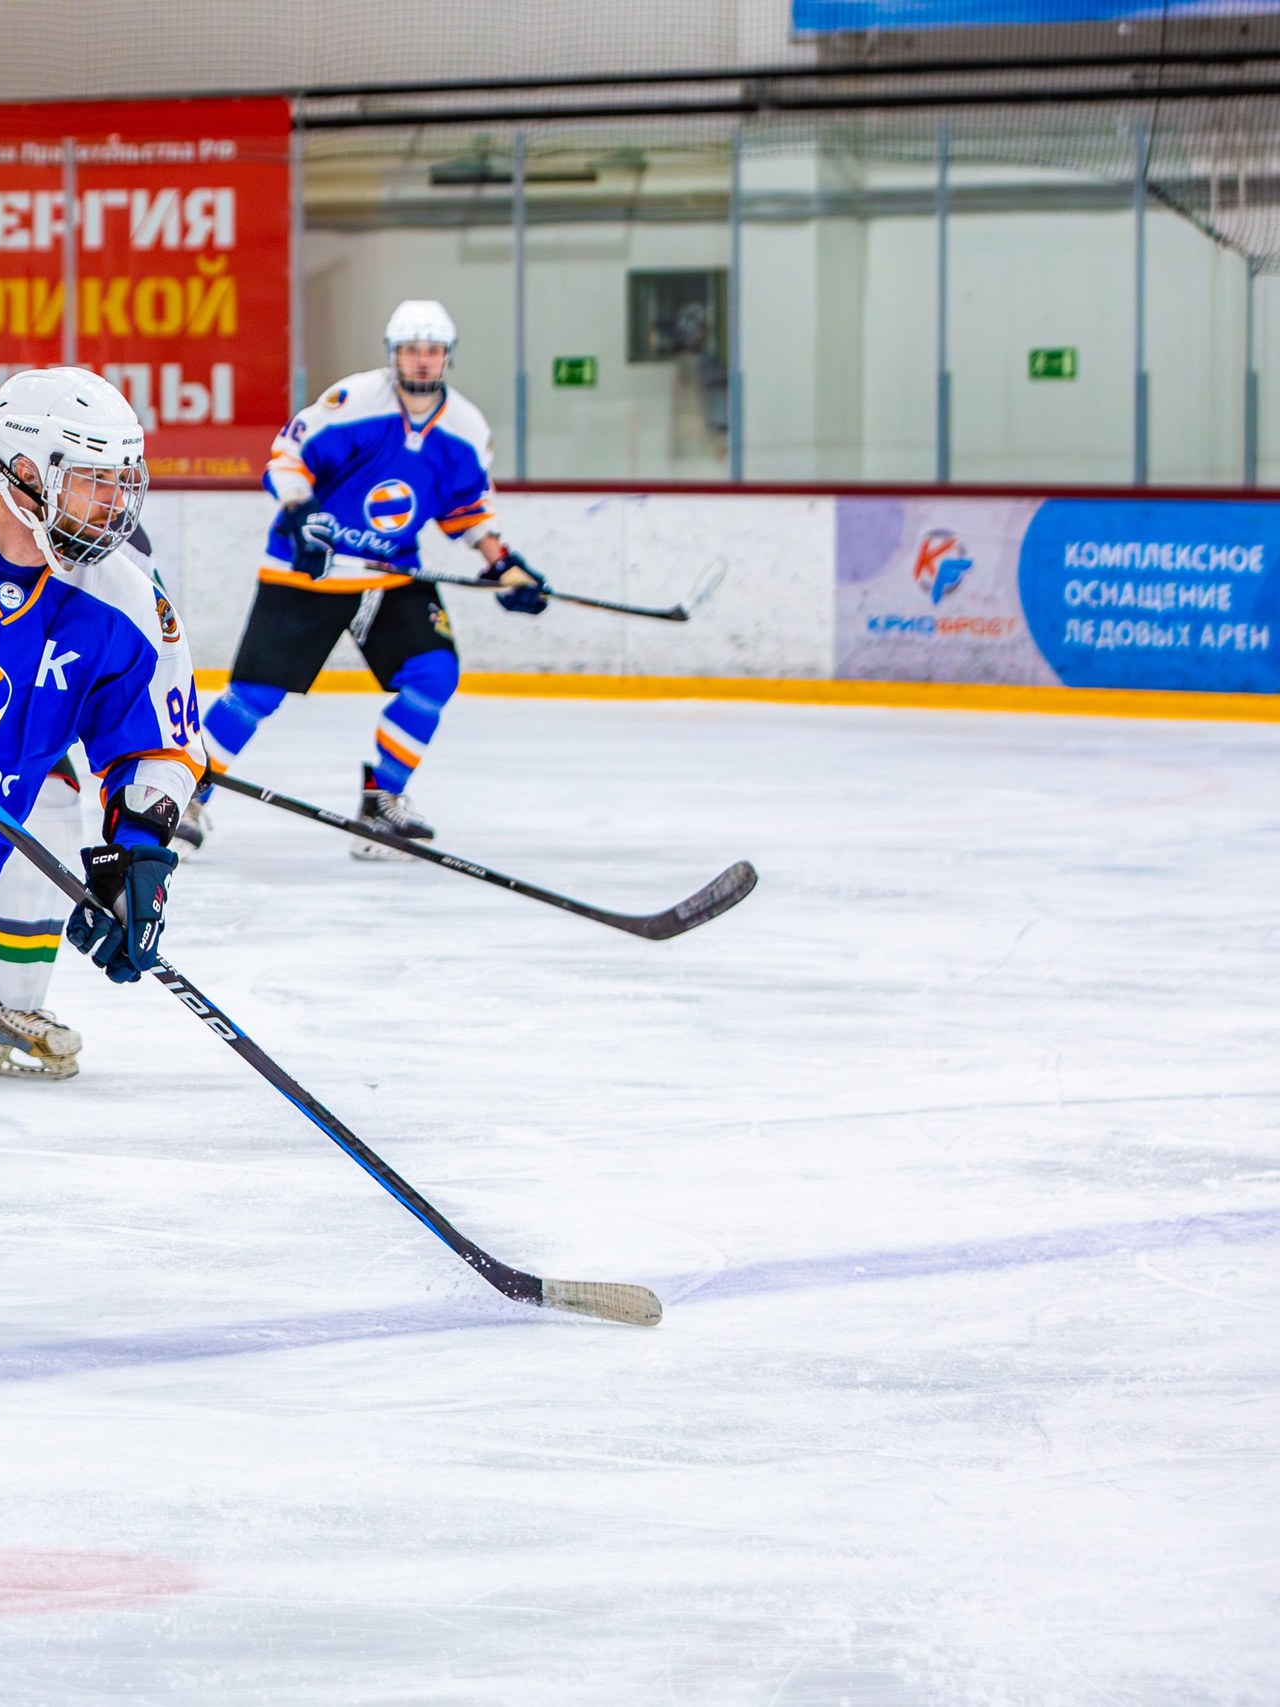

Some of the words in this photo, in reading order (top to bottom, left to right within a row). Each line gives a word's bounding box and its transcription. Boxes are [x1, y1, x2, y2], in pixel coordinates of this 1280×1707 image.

[4, 420, 40, 435] BAUER
[122, 437, 142, 446] BAUER
[1064, 542, 1265, 574] КОМПЛЕКСНОЕ
[1064, 579, 1232, 613] ОСНАЩЕНИЕ
[1064, 618, 1191, 650] ЛЕДОВЫХ
[1200, 622, 1269, 651] АРЕН
[165, 673, 201, 748] 94
[92, 852, 120, 865] CCM
[139, 922, 152, 950] CCM
